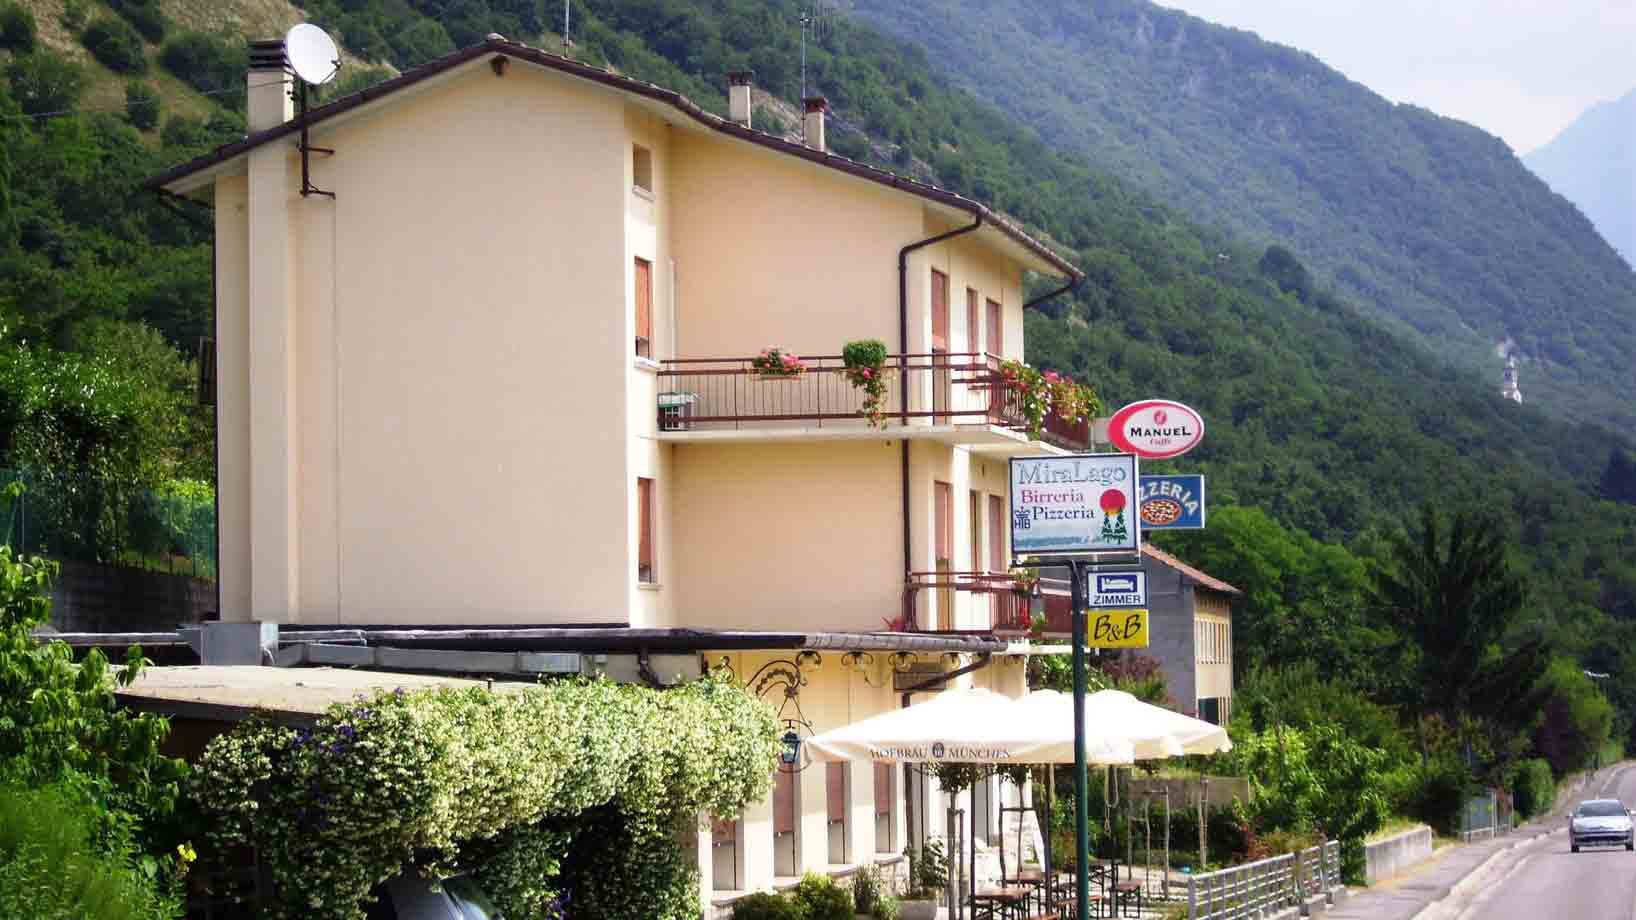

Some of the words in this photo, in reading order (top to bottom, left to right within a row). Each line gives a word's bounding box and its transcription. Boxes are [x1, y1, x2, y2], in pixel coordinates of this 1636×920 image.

[1130, 425, 1192, 437] MANUEL
[1016, 461, 1127, 487] MiraLago
[1021, 488, 1084, 504] Birreria
[1139, 480, 1199, 517] ZZERIA
[1032, 505, 1096, 521] Pizzeria
[1094, 594, 1141, 605] ZIMMER
[1094, 614, 1141, 642] B&B
